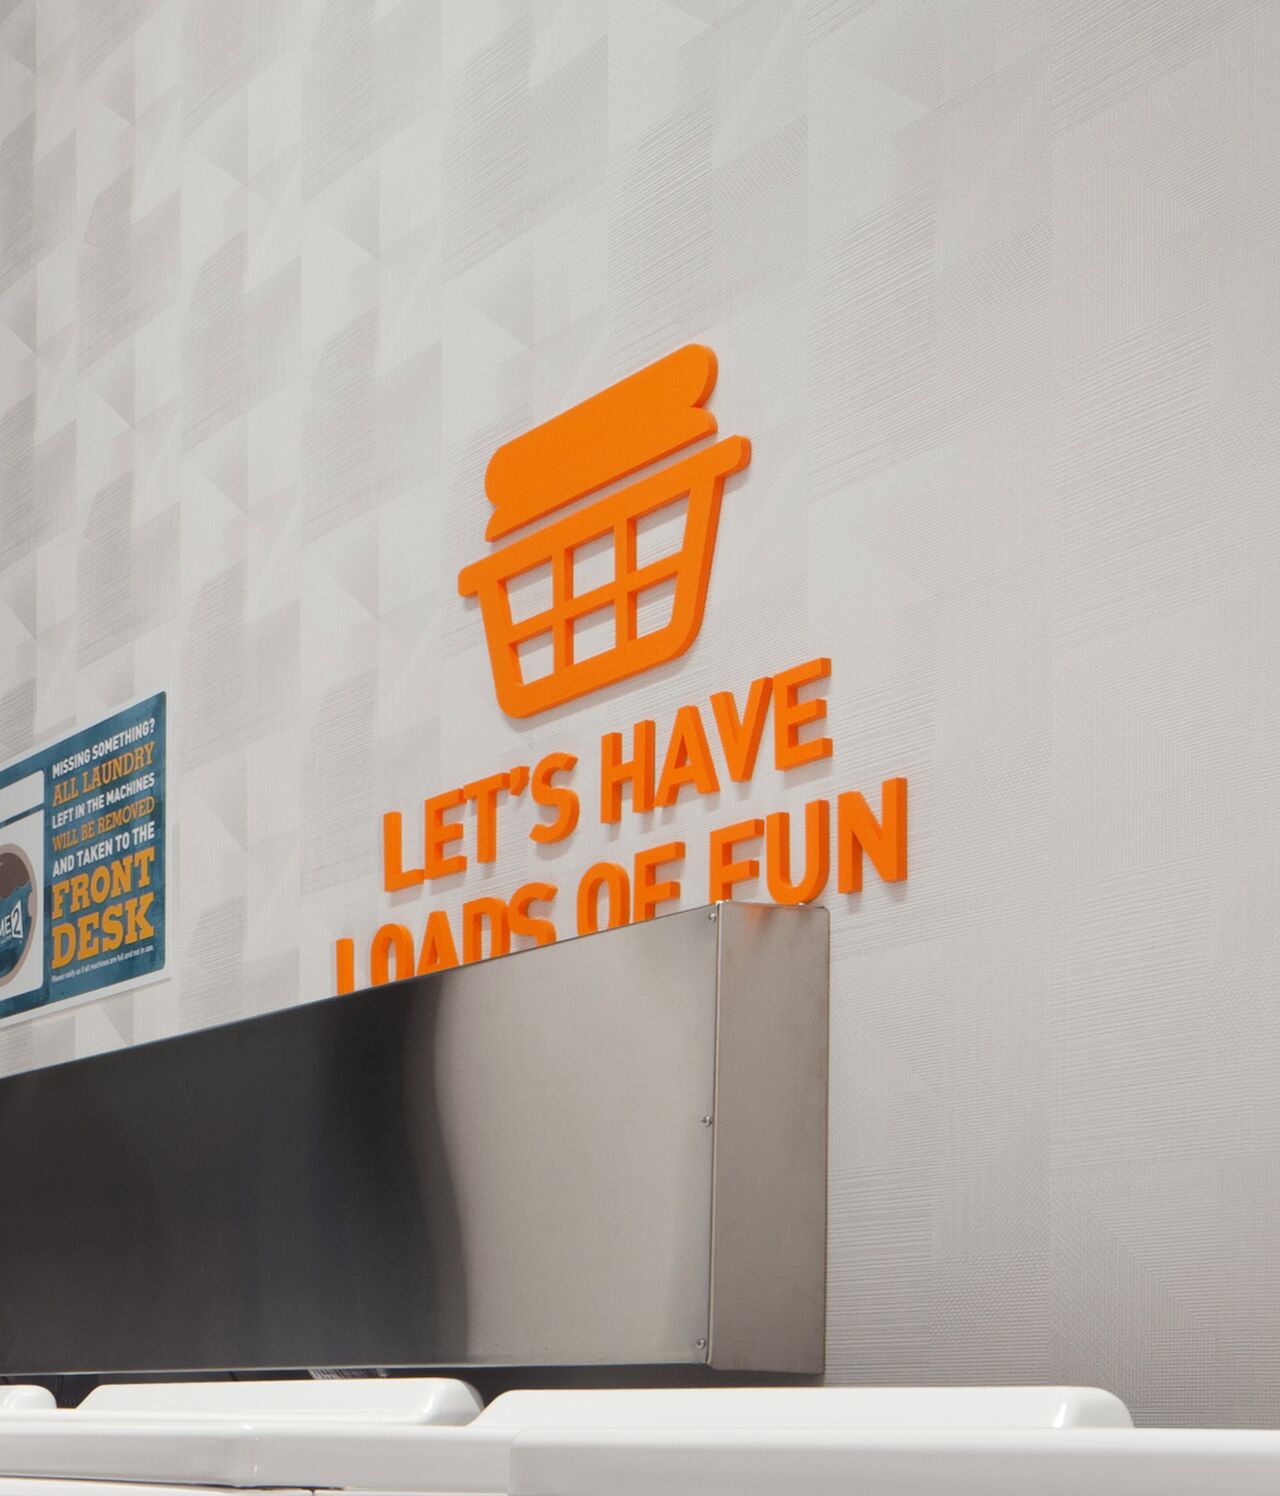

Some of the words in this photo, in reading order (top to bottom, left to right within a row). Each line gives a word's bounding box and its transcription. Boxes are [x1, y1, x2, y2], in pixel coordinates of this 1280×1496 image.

[52, 749, 91, 779] MISSING
[92, 718, 155, 760] SOMETHING?
[52, 777, 79, 807] ALL
[82, 741, 155, 793] LAUNDRY
[383, 752, 581, 892] LET'S
[600, 657, 833, 824] HAVE
[52, 808, 74, 829] LEFT
[75, 803, 86, 819] IN
[86, 794, 105, 813] THE
[106, 772, 155, 806] MACHINES
[52, 829, 79, 852] WILL
[81, 821, 96, 841] BE
[97, 796, 155, 834] REMOVED
[52, 855, 75, 877] AND
[77, 838, 113, 867] TAKEN
[115, 832, 130, 852] TO
[132, 821, 155, 845] THE
[709, 777, 908, 905] FUN
[51, 846, 155, 921] FRONT
[51, 892, 155, 970] DESK
